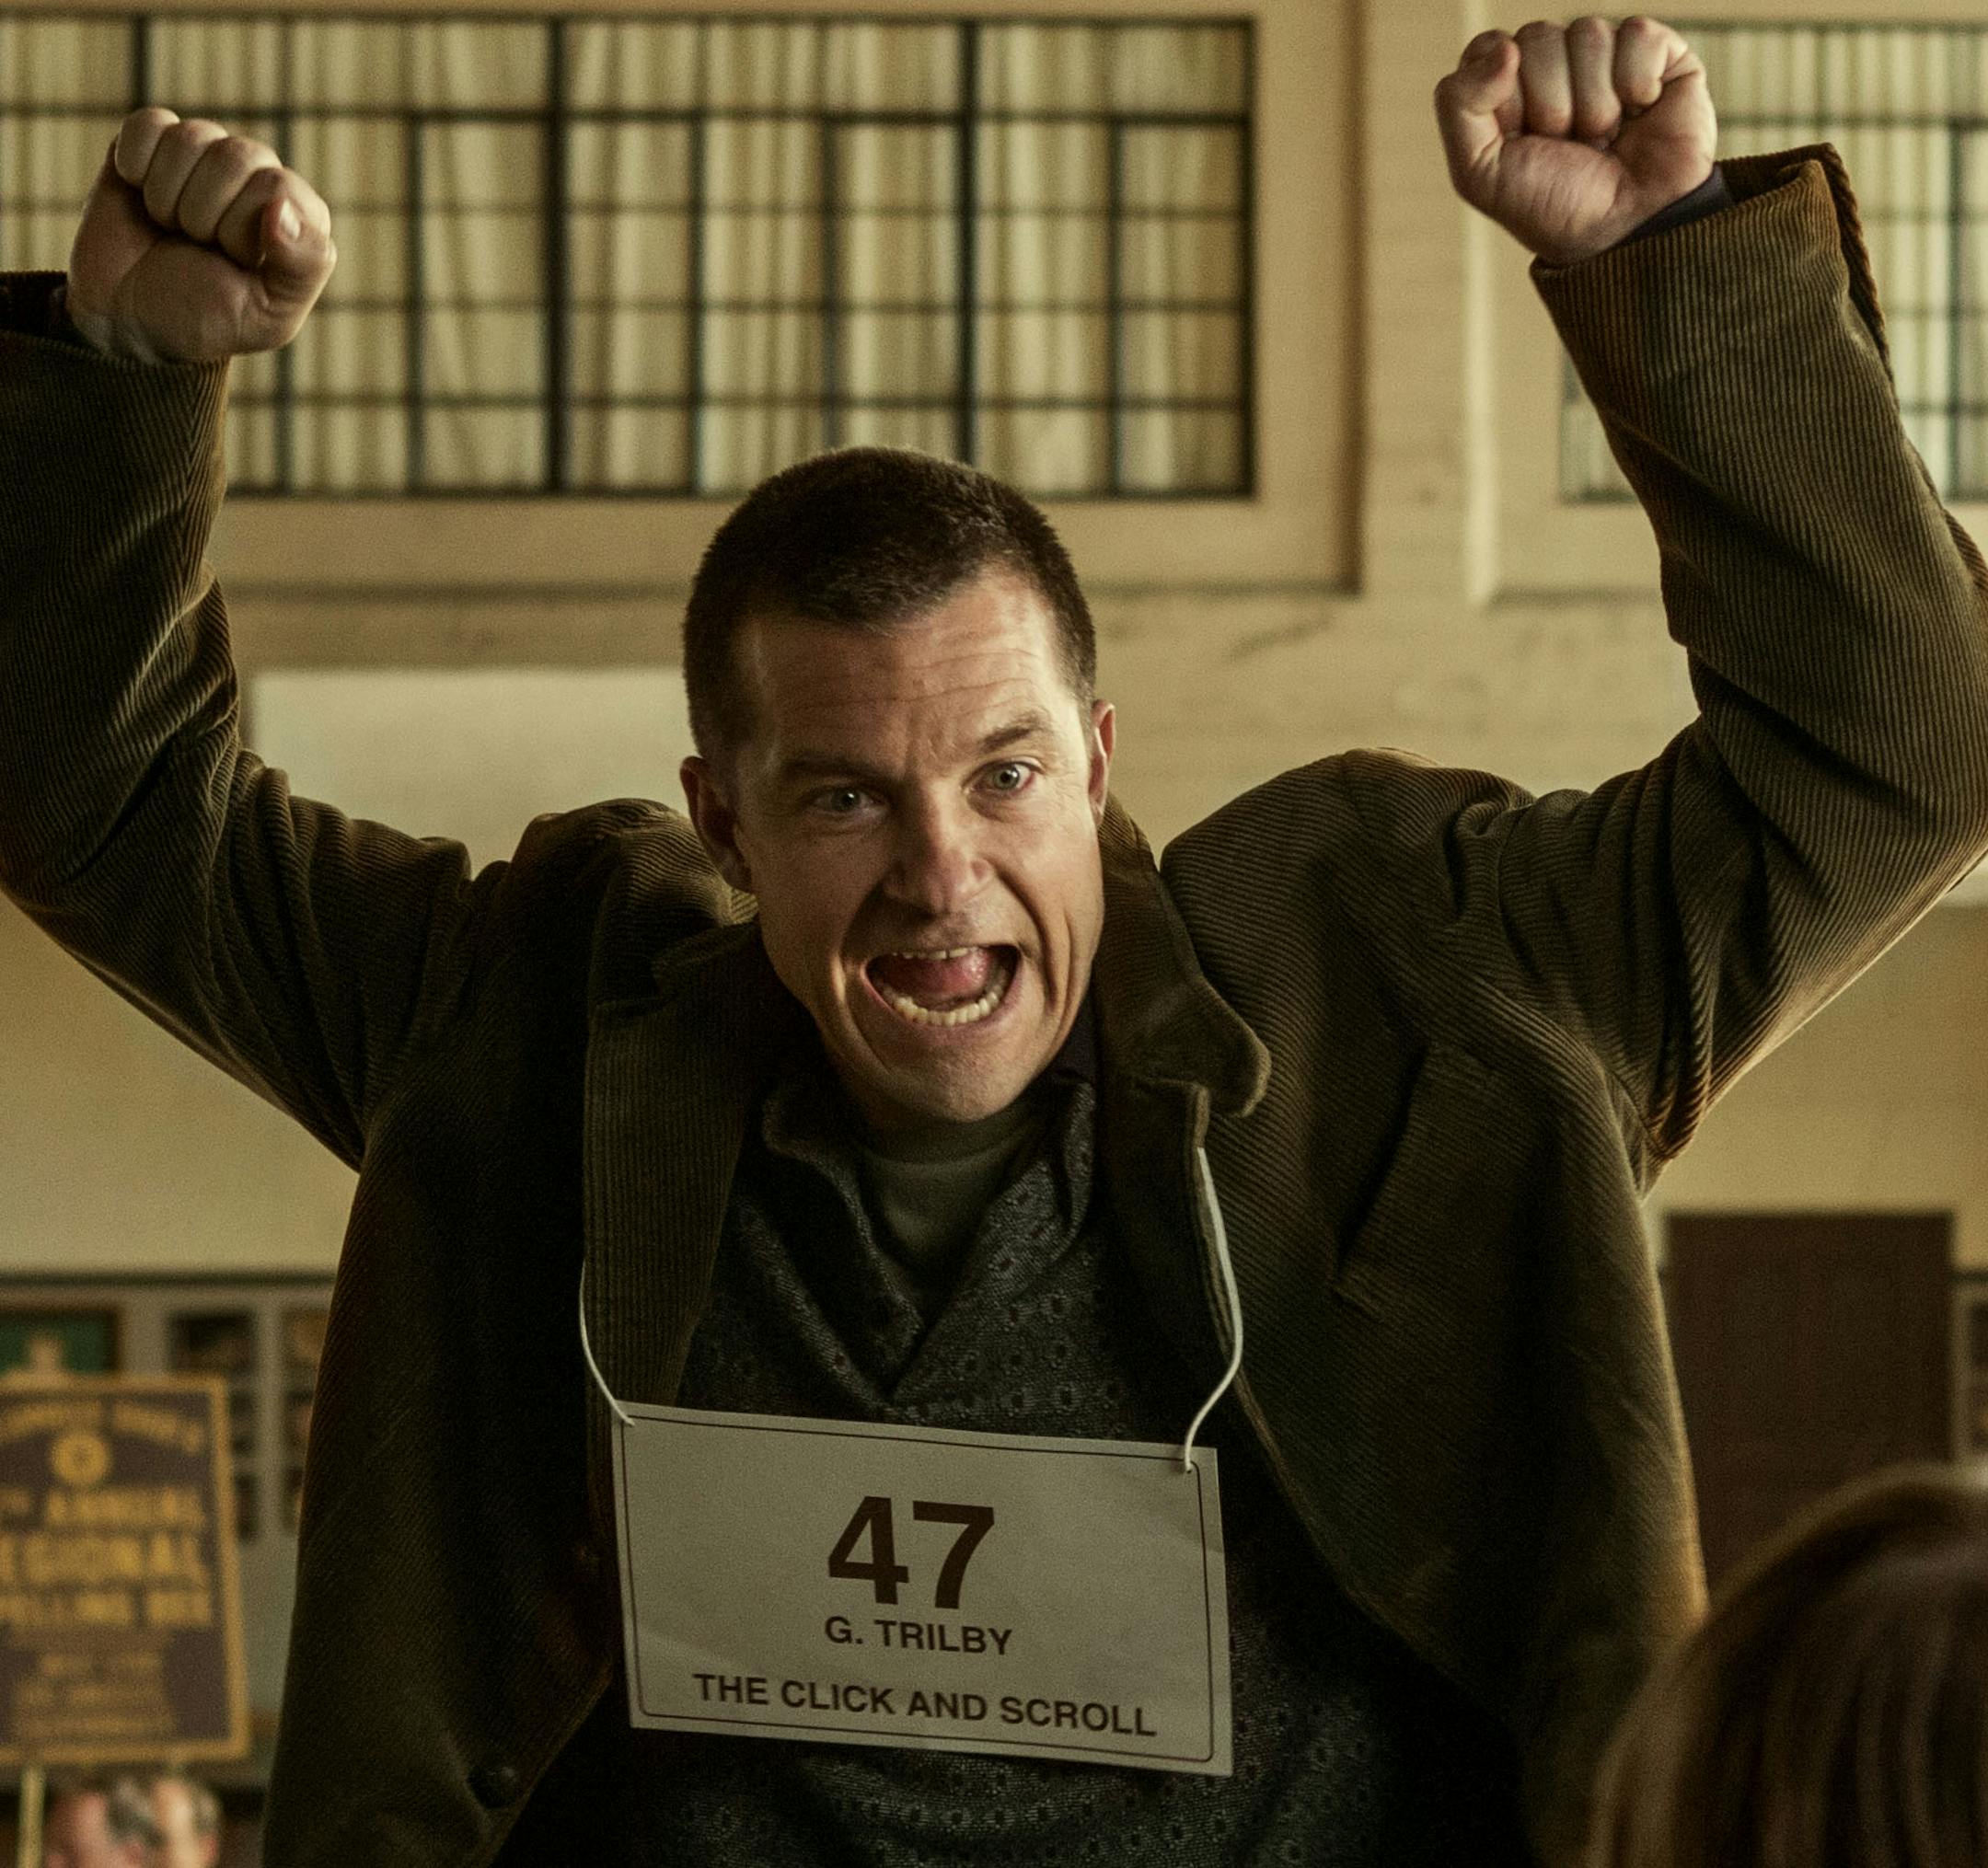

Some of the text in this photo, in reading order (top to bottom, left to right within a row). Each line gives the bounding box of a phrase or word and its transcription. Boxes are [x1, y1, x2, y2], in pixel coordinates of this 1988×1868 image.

[828, 1495, 995, 1609] 47
[824, 1616, 1012, 1655] G. TRILBY
[693, 1673, 1158, 1737] THE CLICK AND SCROLL
